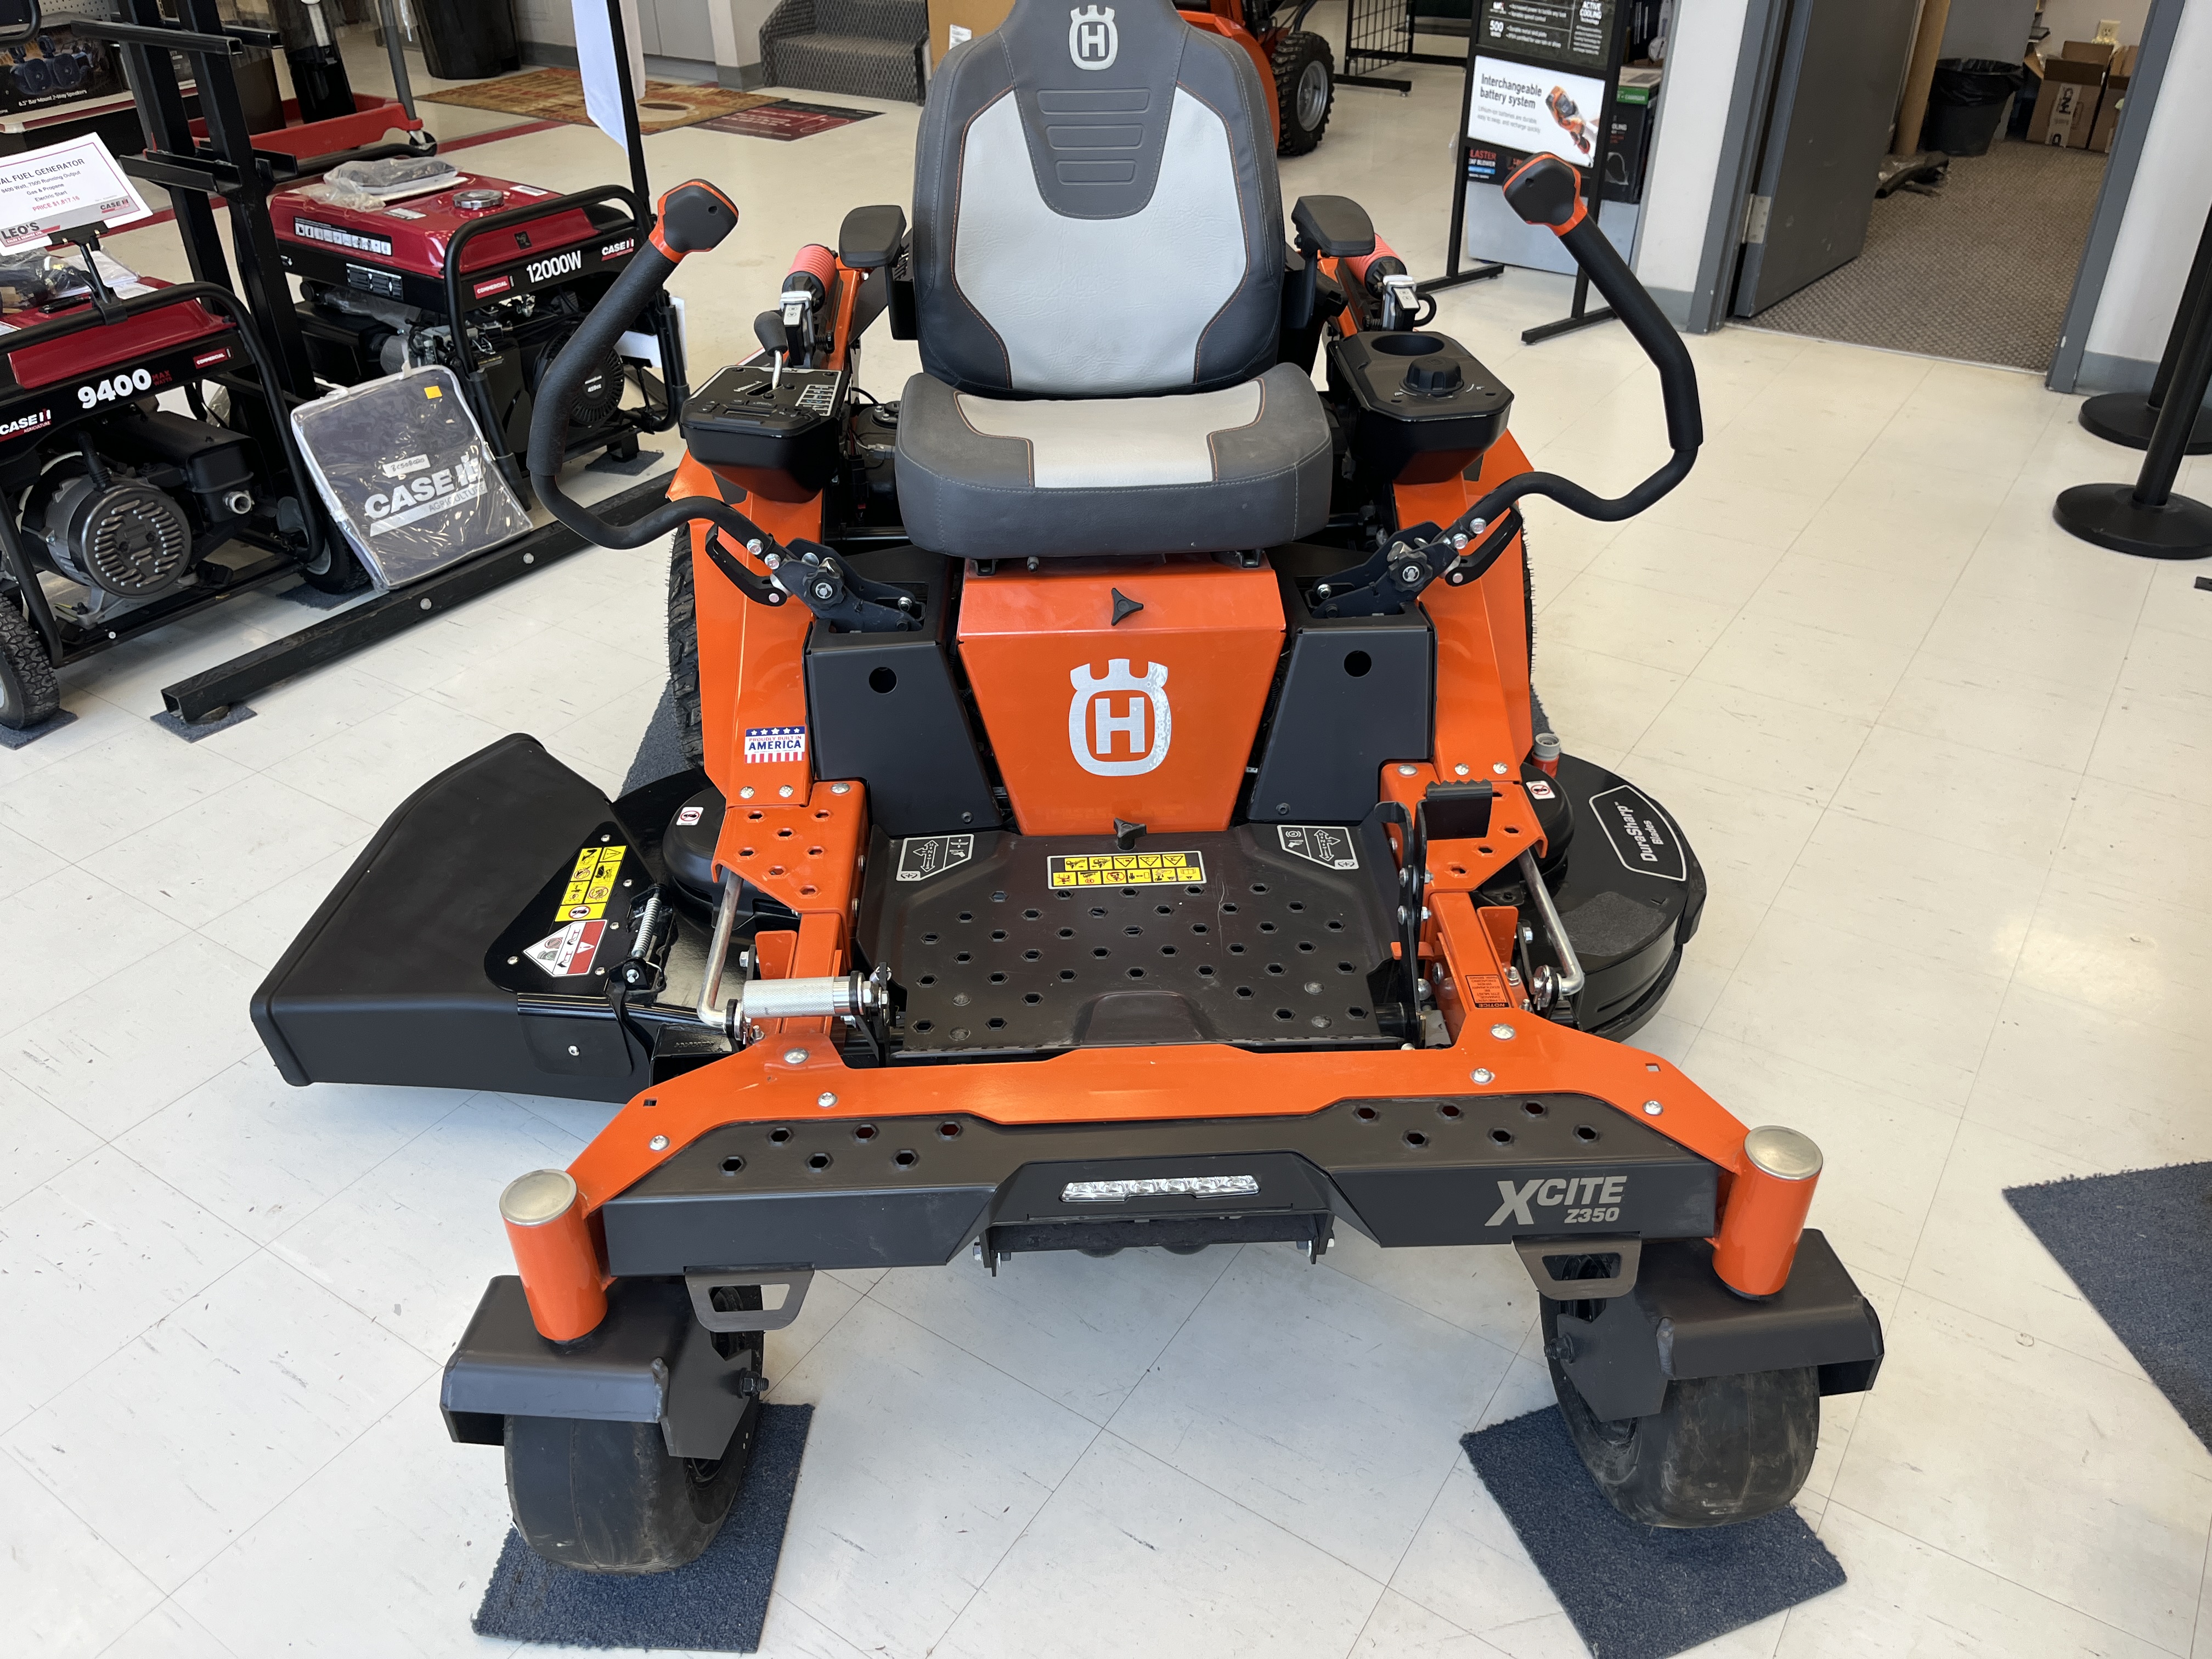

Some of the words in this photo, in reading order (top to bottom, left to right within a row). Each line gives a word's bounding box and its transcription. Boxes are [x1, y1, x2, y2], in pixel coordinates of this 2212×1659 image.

[1489, 20, 1504, 32] 500
[1481, 73, 1542, 97] Interchangeable
[1480, 86, 1506, 105] battery
[1509, 95, 1536, 110] system
[1470, 149, 1497, 161] LASTER
[14, 172, 35, 182] FUEL
[35, 159, 85, 176] GENERATOR
[64, 171, 81, 179] Output
[43, 183, 65, 192] Propane
[35, 194, 54, 202] Electric
[100, 201, 120, 210] CASE
[32, 202, 52, 212] PRICE
[1, 222, 40, 239] LEO'S
[601, 241, 625, 256] CASE
[526, 250, 582, 283] 12000W
[152, 370, 170, 381] MAX
[77, 368, 152, 409] 9400
[0, 414, 38, 435] CASE
[24, 420, 51, 433] AGRICULTURE
[364, 467, 455, 518] CASE
[1094, 697, 1145, 754] H
[748, 740, 801, 751] AMERICA
[1643, 820, 1664, 845] Blades
[1485, 1176, 1627, 1226] XCITE
[1564, 1207, 1620, 1223] Z350
